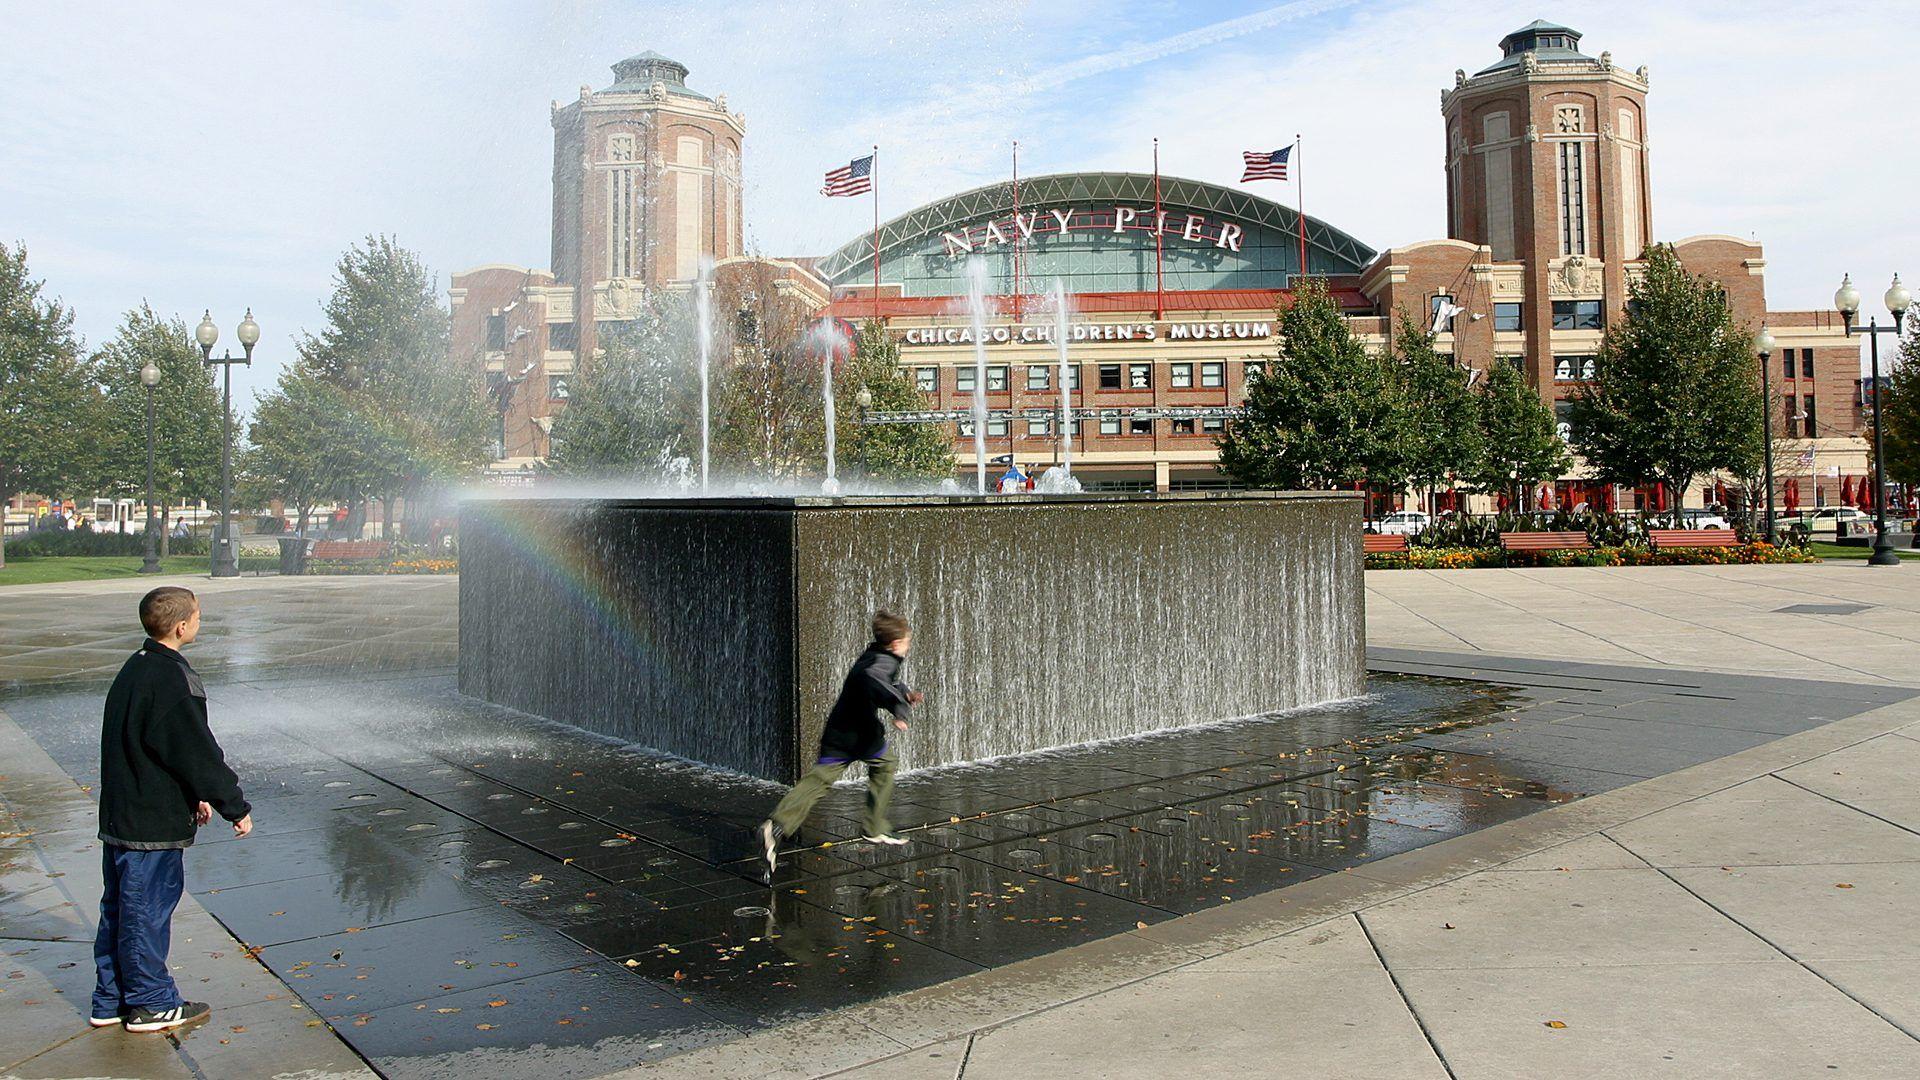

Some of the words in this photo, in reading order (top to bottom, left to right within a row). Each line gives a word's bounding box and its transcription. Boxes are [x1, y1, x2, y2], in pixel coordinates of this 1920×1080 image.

[942, 208, 1075, 258] NAVY
[1113, 206, 1242, 253] PIER
[906, 327, 1009, 343] CHICAGO
[1170, 322, 1271, 340] MUSEUM
